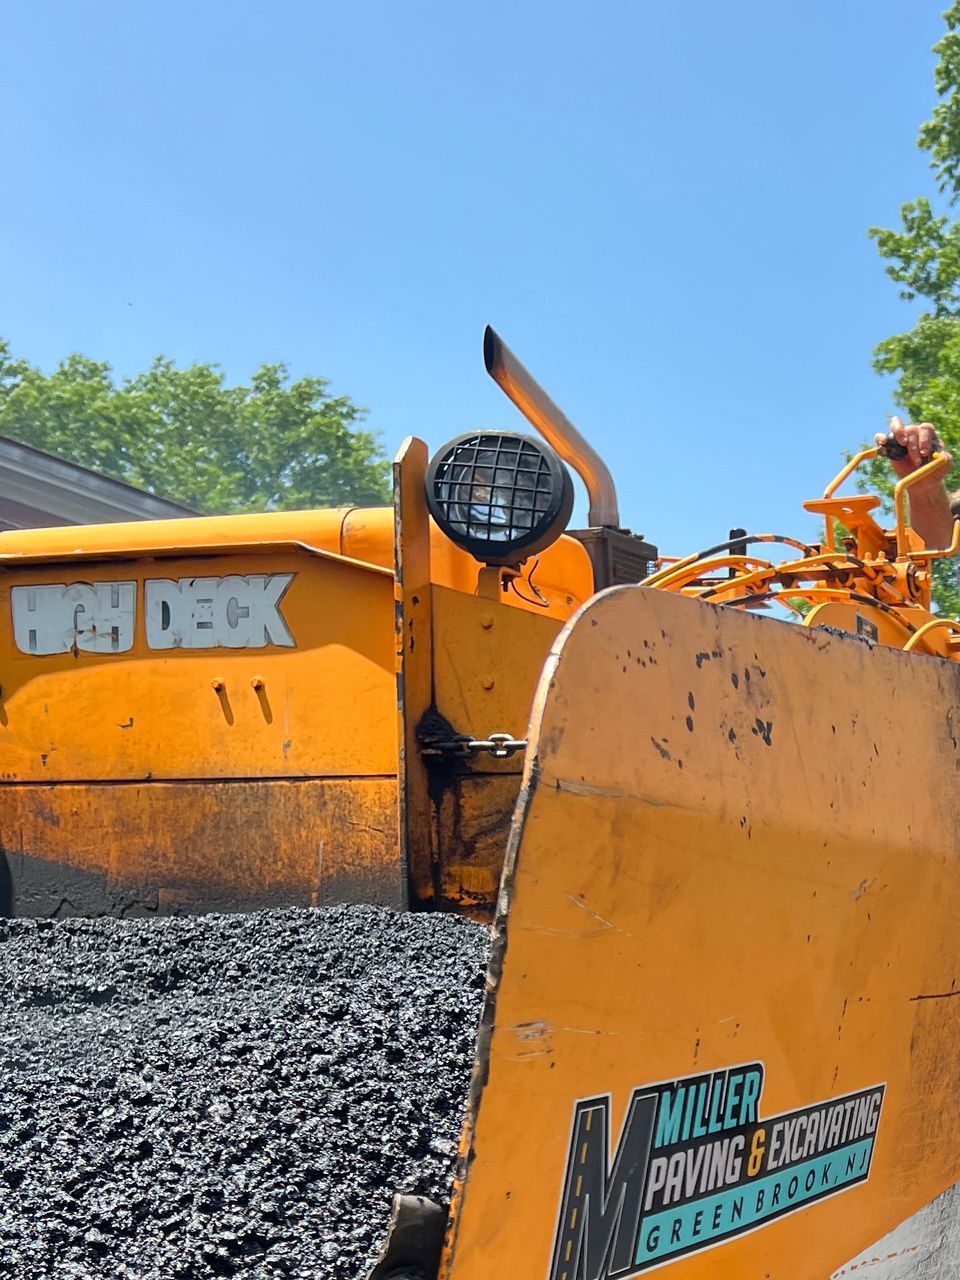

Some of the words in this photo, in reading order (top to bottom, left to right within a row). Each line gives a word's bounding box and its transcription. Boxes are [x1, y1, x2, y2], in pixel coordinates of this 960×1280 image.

[144, 573, 298, 650] DECK
[644, 1135, 745, 1212] PAVING
[747, 1128, 766, 1177] &
[767, 1092, 882, 1171] EXCAVATING
[655, 1071, 760, 1149] MILLER
[646, 1197, 744, 1253] GREEN
[845, 1148, 867, 1176] NJ
